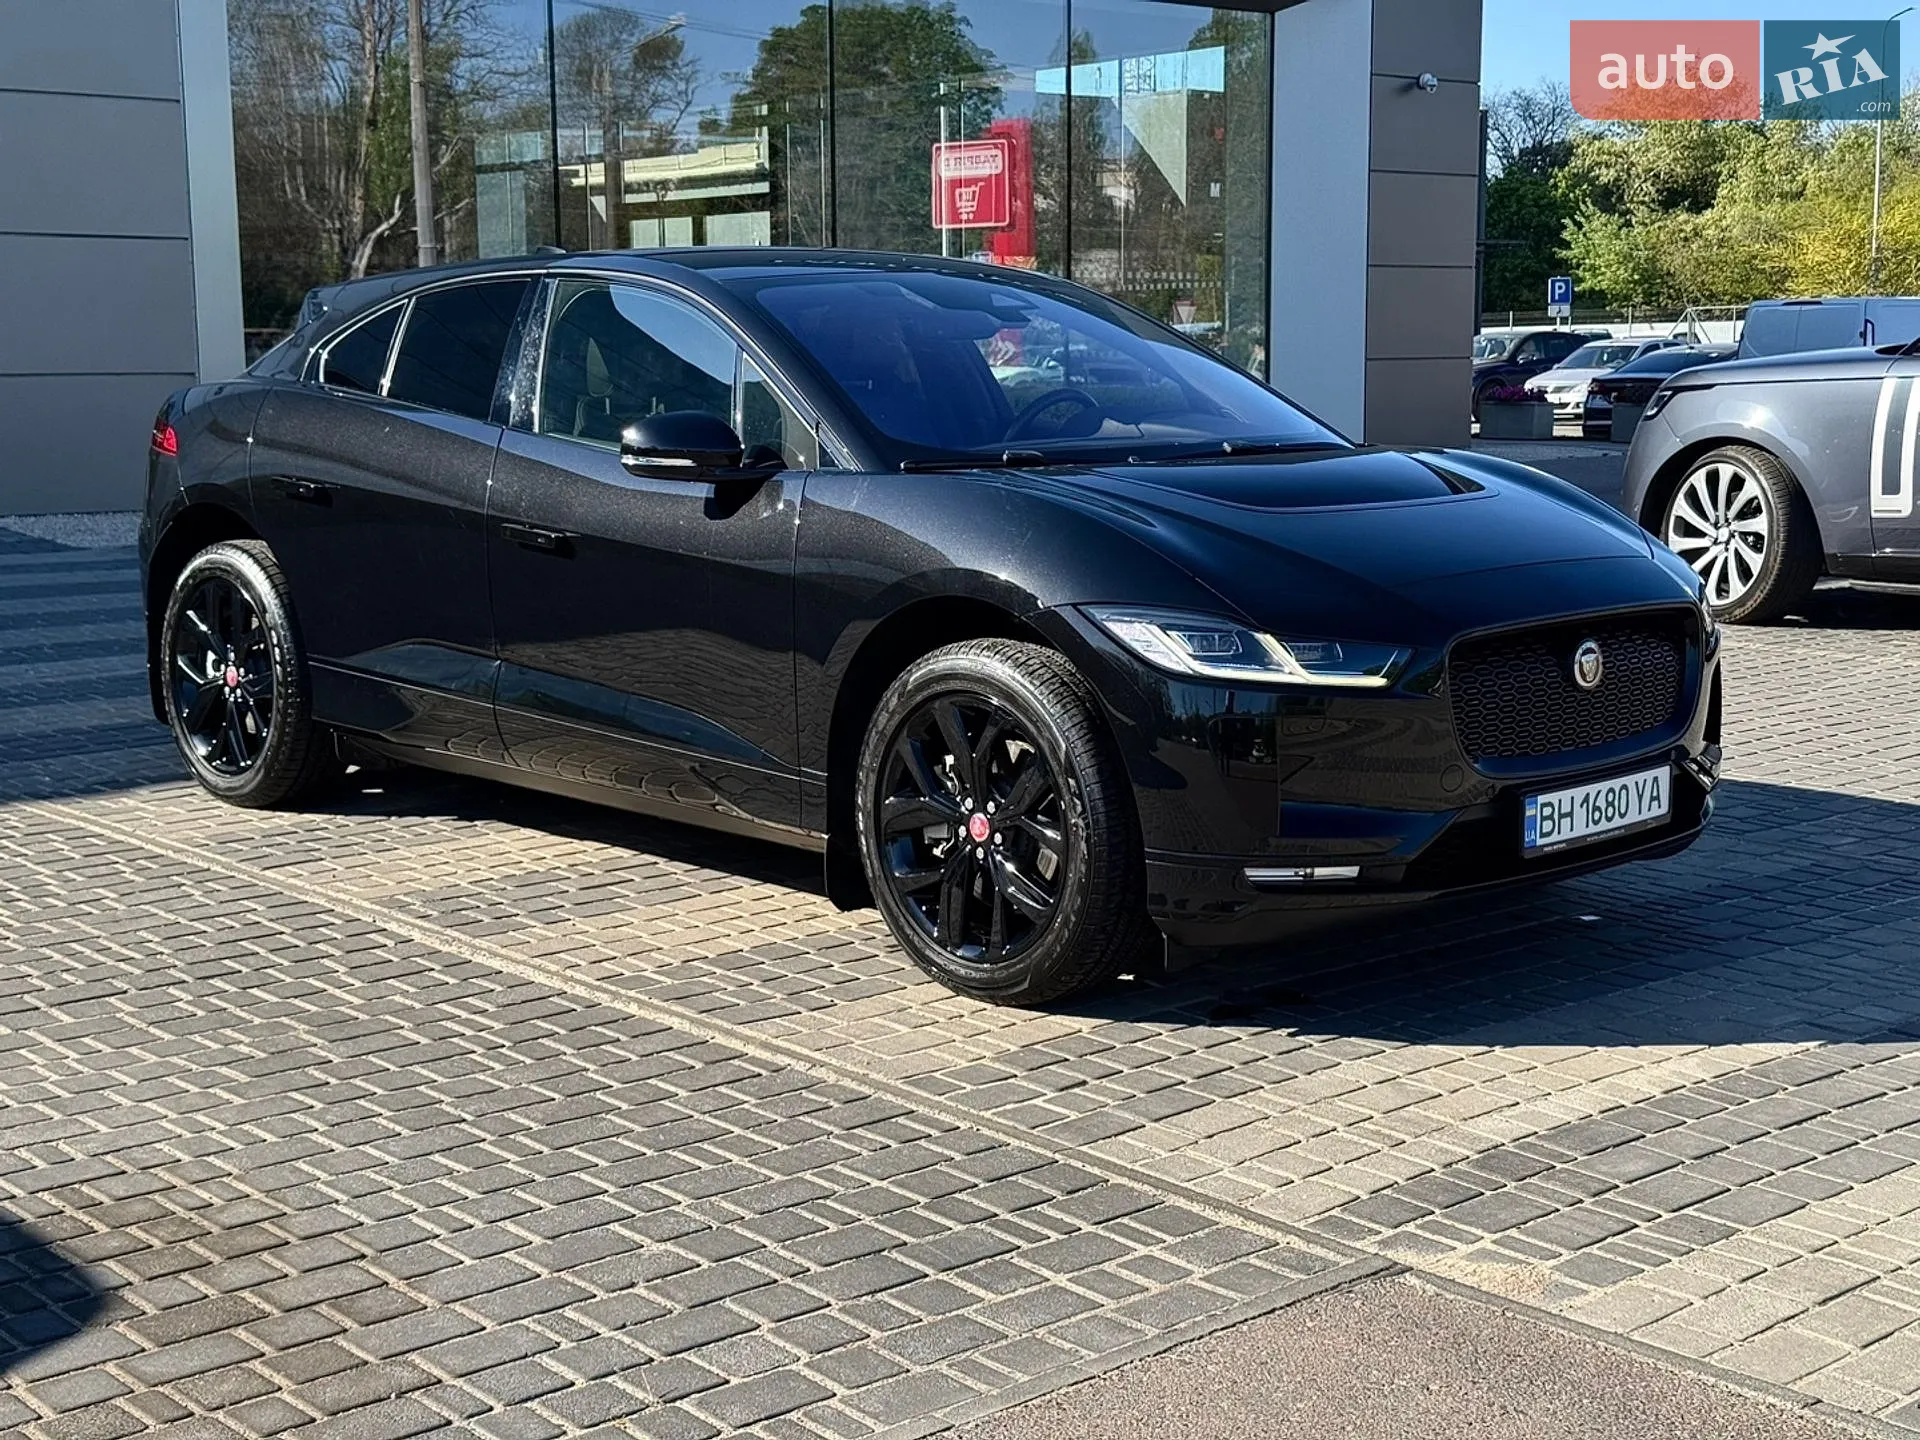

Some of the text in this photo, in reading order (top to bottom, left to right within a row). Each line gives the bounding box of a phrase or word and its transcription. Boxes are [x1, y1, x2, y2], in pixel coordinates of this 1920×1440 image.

[1554, 282, 1566, 300] P
[1539, 775, 1661, 839] BH 1680 YA
[1524, 830, 1536, 842] UA
